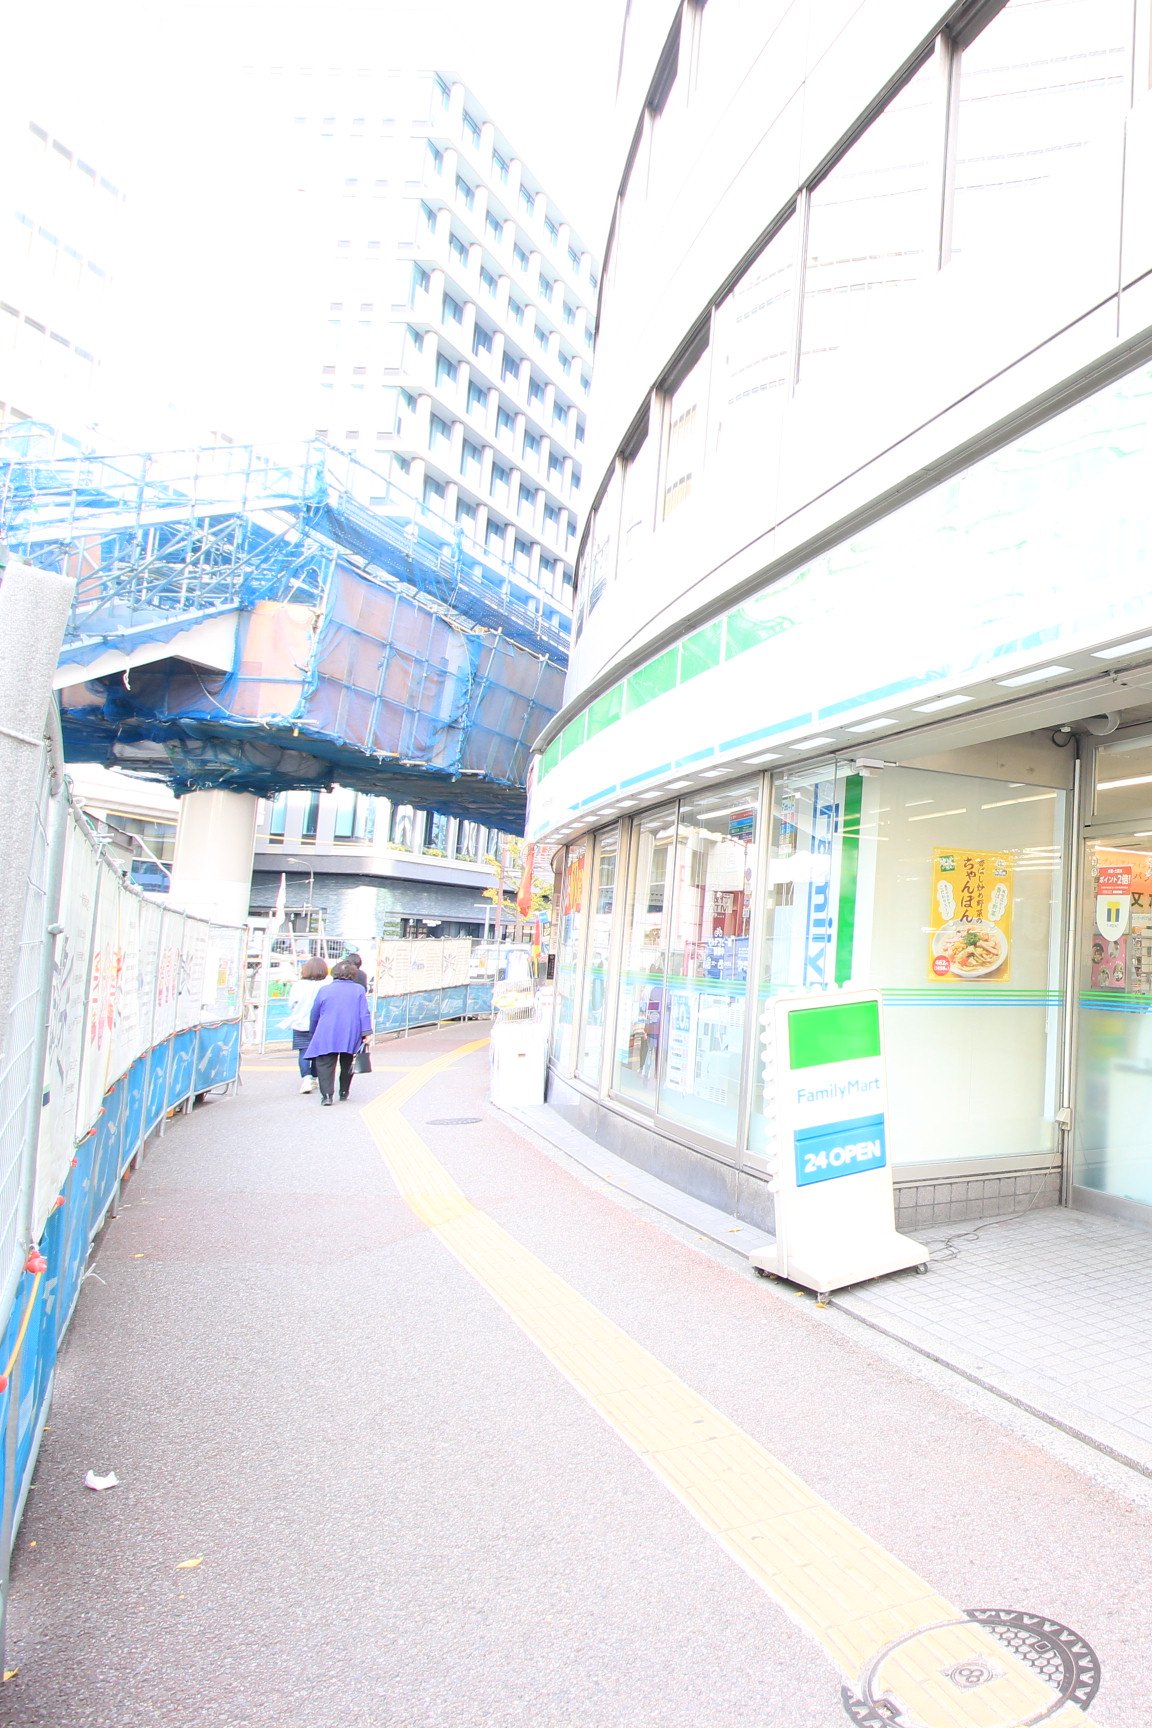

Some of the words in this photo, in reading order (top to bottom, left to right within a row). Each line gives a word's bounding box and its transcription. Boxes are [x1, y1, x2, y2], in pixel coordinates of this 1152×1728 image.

[959, 857, 978, 923] ちゃんぽん
[797, 1076, 881, 1104] FamilyMart
[804, 1151, 829, 1173] 24
[829, 1139, 881, 1168] OPEN
